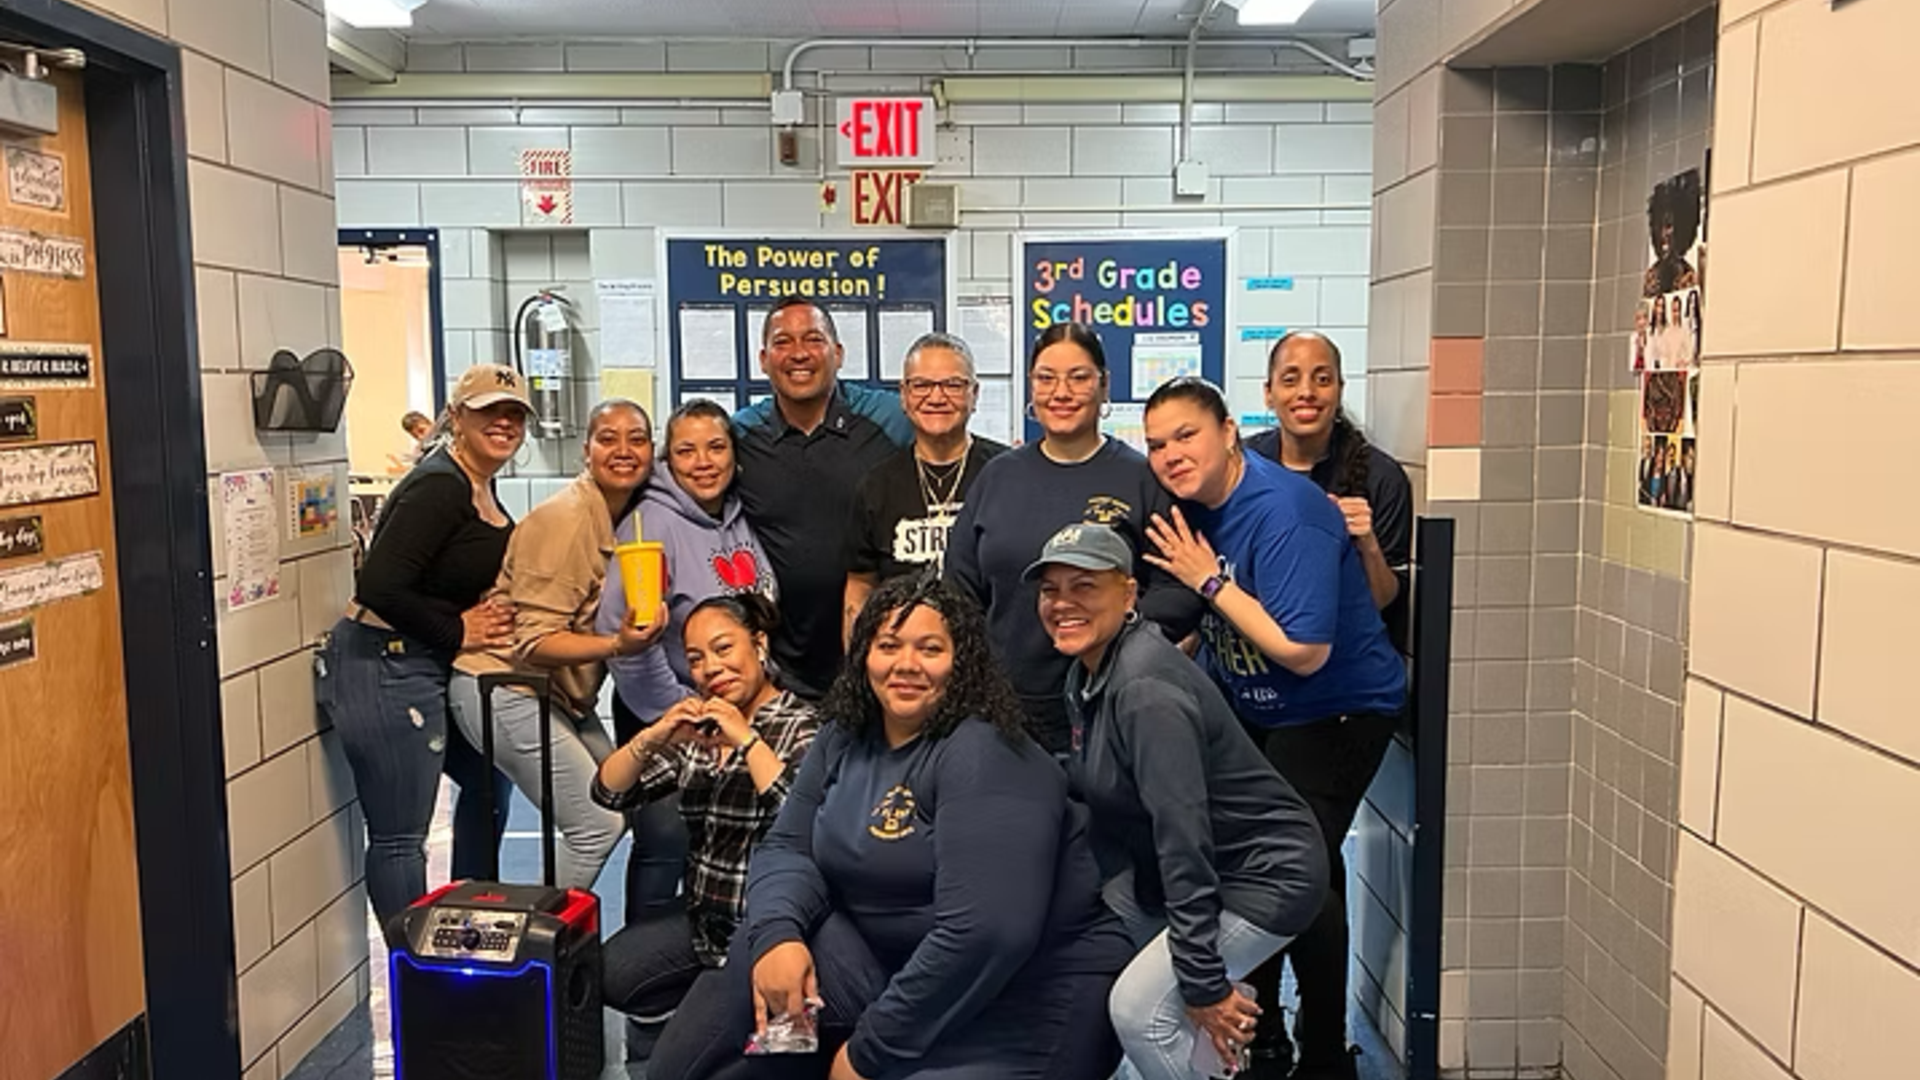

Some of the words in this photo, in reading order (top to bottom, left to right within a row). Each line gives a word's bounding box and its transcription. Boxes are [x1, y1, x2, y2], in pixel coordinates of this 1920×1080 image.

[855, 102, 923, 157] EXIT
[530, 161, 562, 176] FIRE
[704, 244, 748, 268] The
[757, 246, 840, 268] Power
[850, 247, 881, 268] of
[1034, 257, 1084, 292] 3rd
[1098, 260, 1202, 289] Grade
[1032, 294, 1211, 329] Schedules
